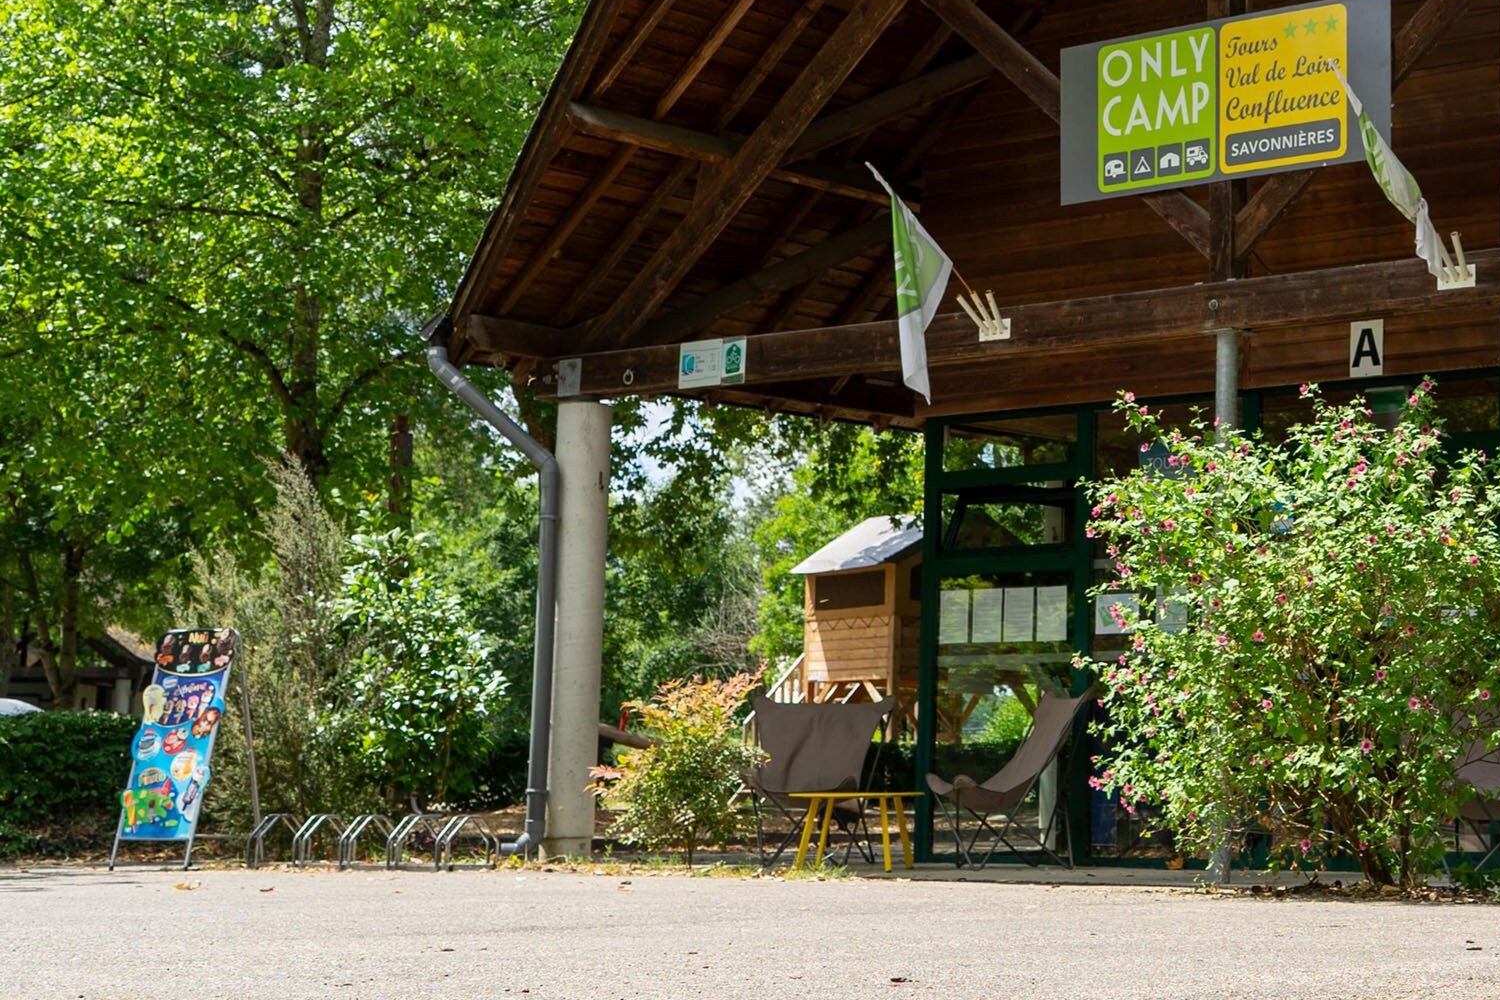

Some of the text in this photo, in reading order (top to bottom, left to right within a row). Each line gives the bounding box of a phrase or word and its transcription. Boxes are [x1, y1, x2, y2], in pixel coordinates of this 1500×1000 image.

[1102, 33, 1210, 87] ONLY
[1225, 36, 1278, 59] Tours
[1225, 63, 1260, 88] Val
[1265, 60, 1286, 82] de
[1102, 81, 1210, 136] CAMP
[1225, 89, 1341, 124] Confluence
[1231, 128, 1335, 157] SAVONNIÈRES
[1352, 328, 1381, 368] A
